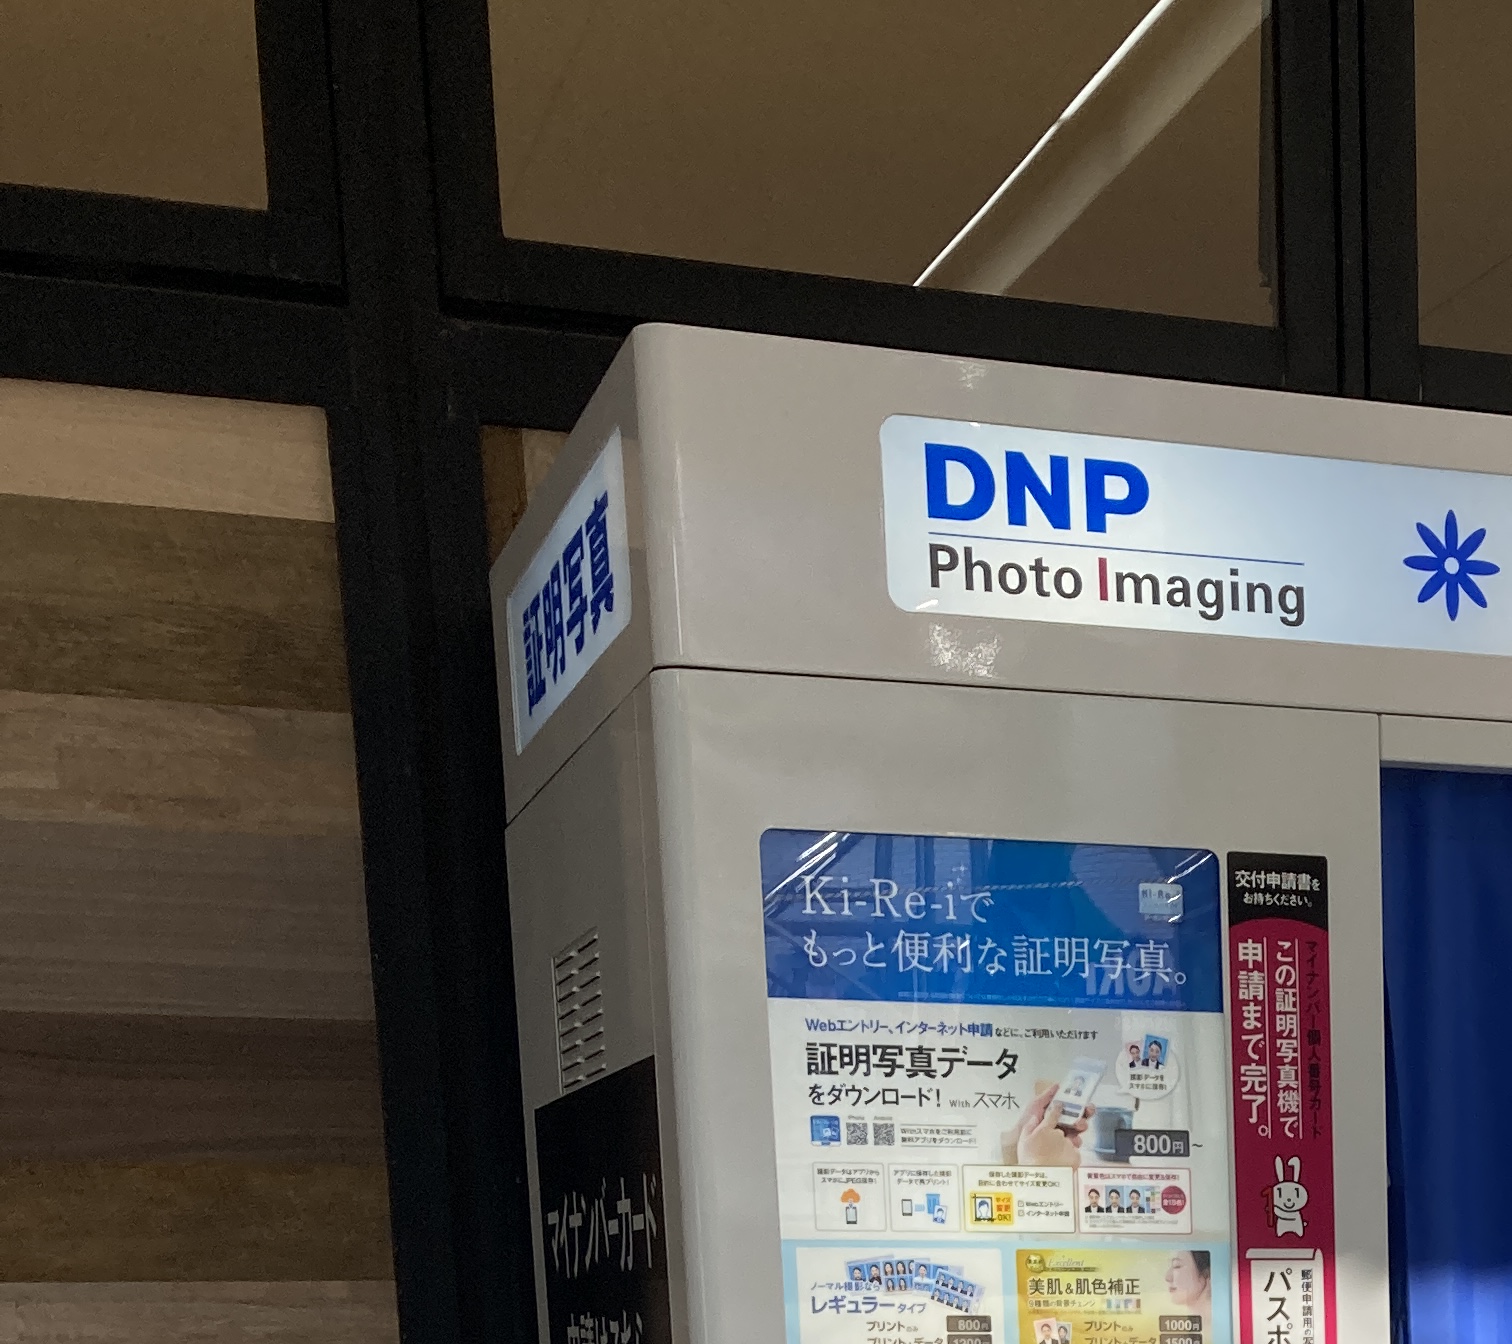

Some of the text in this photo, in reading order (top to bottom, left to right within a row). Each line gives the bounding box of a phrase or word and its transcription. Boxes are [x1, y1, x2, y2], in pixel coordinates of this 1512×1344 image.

[923, 443, 1150, 533] DNP
[522, 489, 615, 717] 証明写真
[928, 544, 1307, 628] Photo Imaging
[1235, 869, 1321, 892] 交付申請書を
[1243, 892, 1313, 907] お持ちください。
[802, 928, 1187, 986] もっと便利な証明写真。
[805, 1042, 1020, 1080] 証明写真データ
[1237, 938, 1270, 1137] 申請まで完了。
[1274, 939, 1300, 1138] この証明写真機で
[808, 1083, 1020, 1109] をダウンロード! With スマホ
[547, 1172, 658, 1279] マイナンバーカード
[811, 1295, 895, 1315] レギュラー
